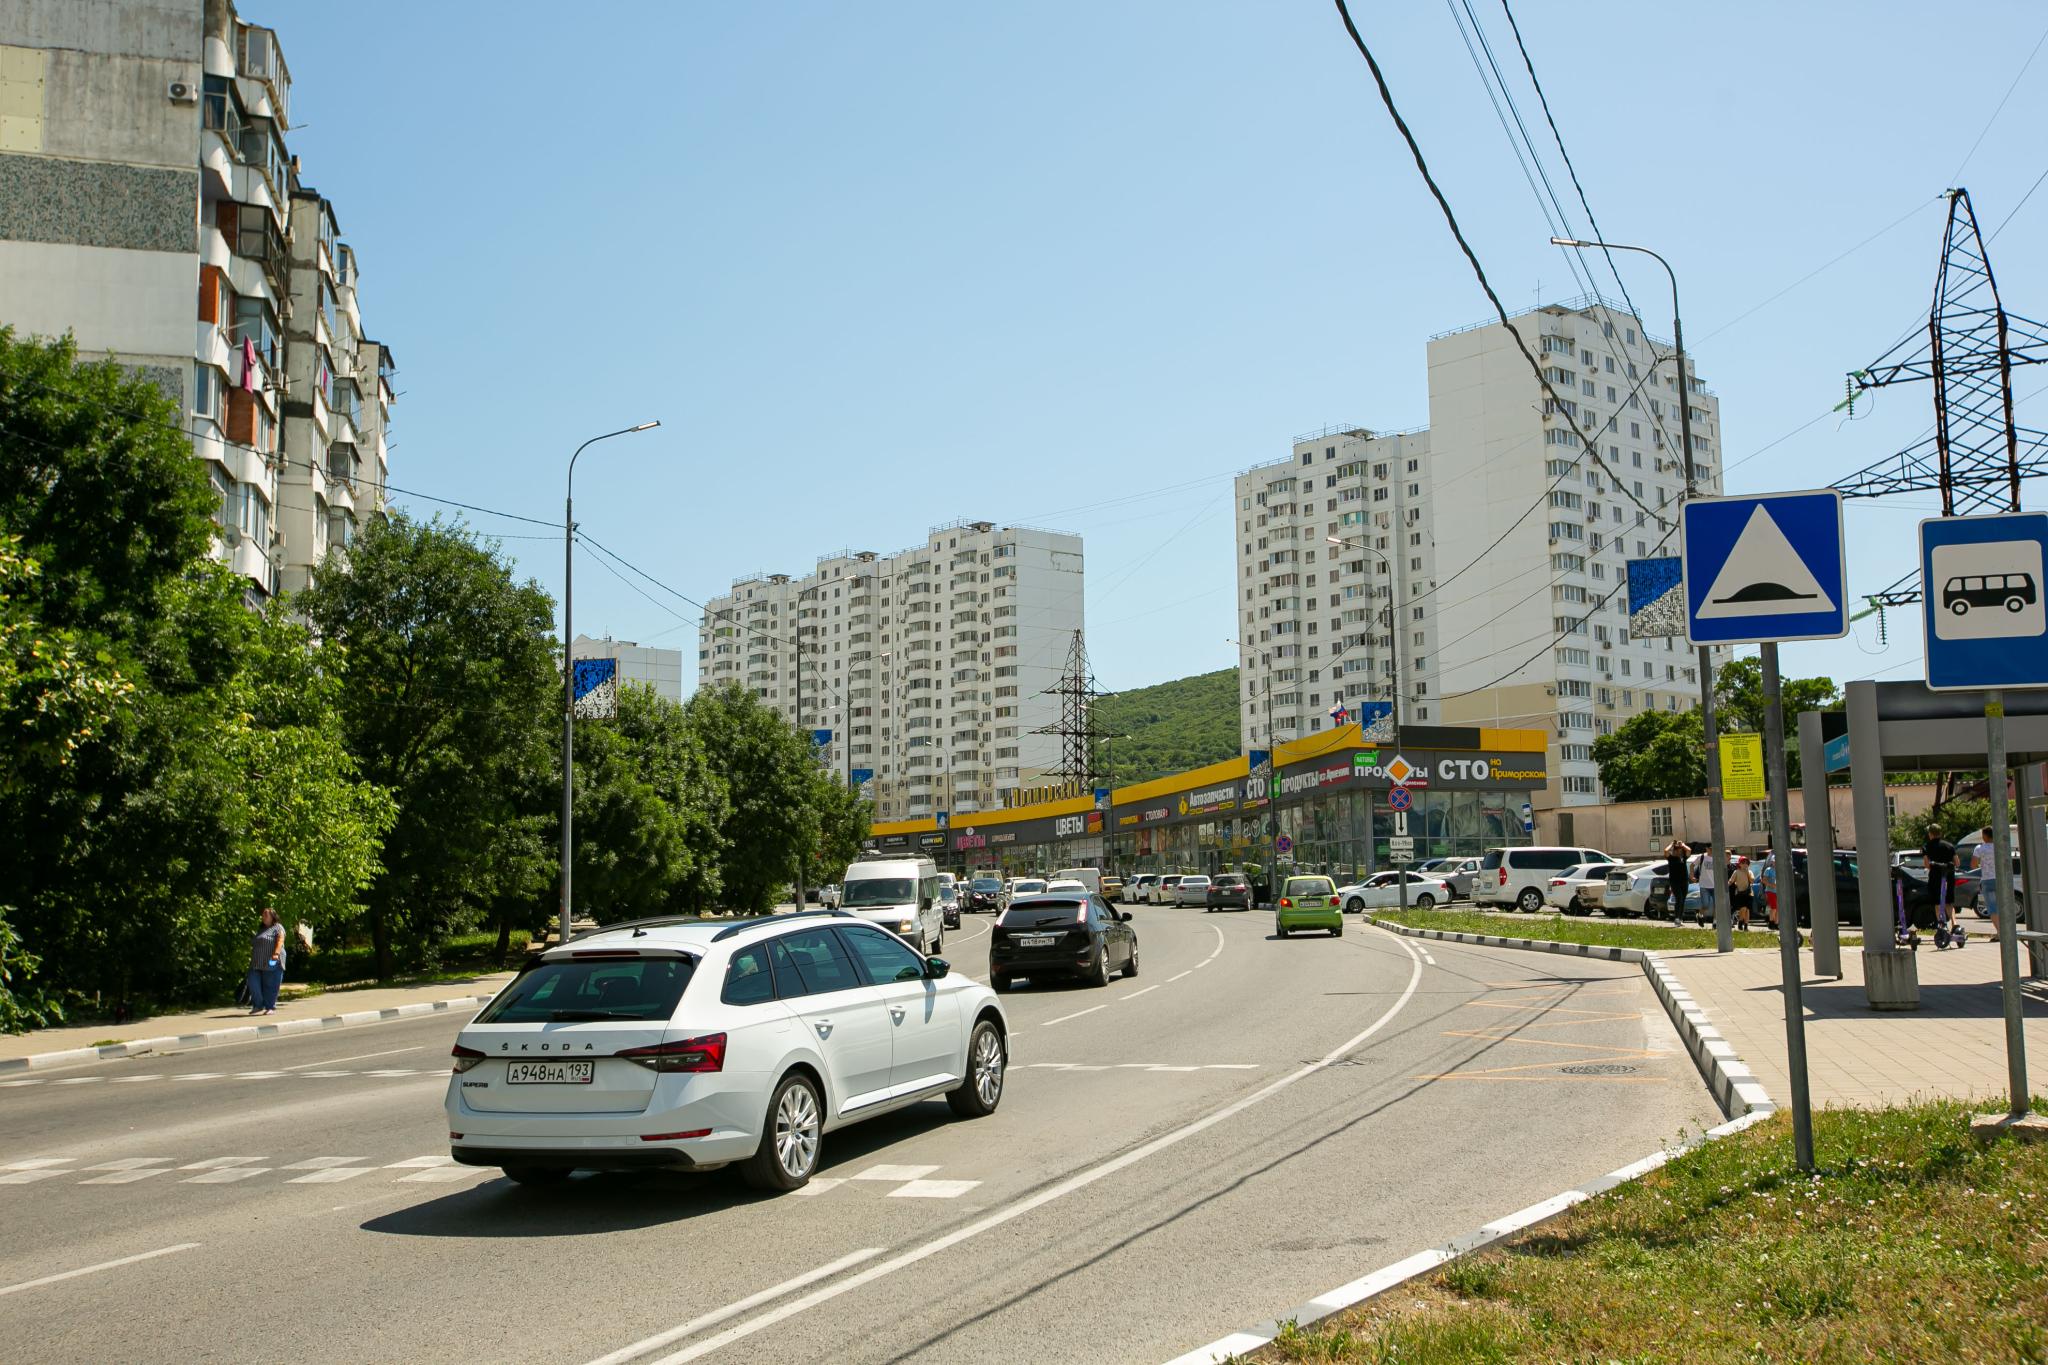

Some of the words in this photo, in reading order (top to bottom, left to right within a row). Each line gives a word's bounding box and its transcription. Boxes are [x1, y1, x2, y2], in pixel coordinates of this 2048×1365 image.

[1438, 759, 1489, 781] СТО
[1490, 758, 1502, 766] на
[1490, 768, 1546, 781] Приморском
[1246, 778, 1265, 800] СТО
[1281, 771, 1320, 794] ПРОДУКТЫ
[1189, 787, 1235, 808] Автозапчасти
[1055, 815, 1084, 837] ЦВЕТЫ
[511, 1065, 565, 1081] А948НА
[568, 1063, 589, 1076] 193
